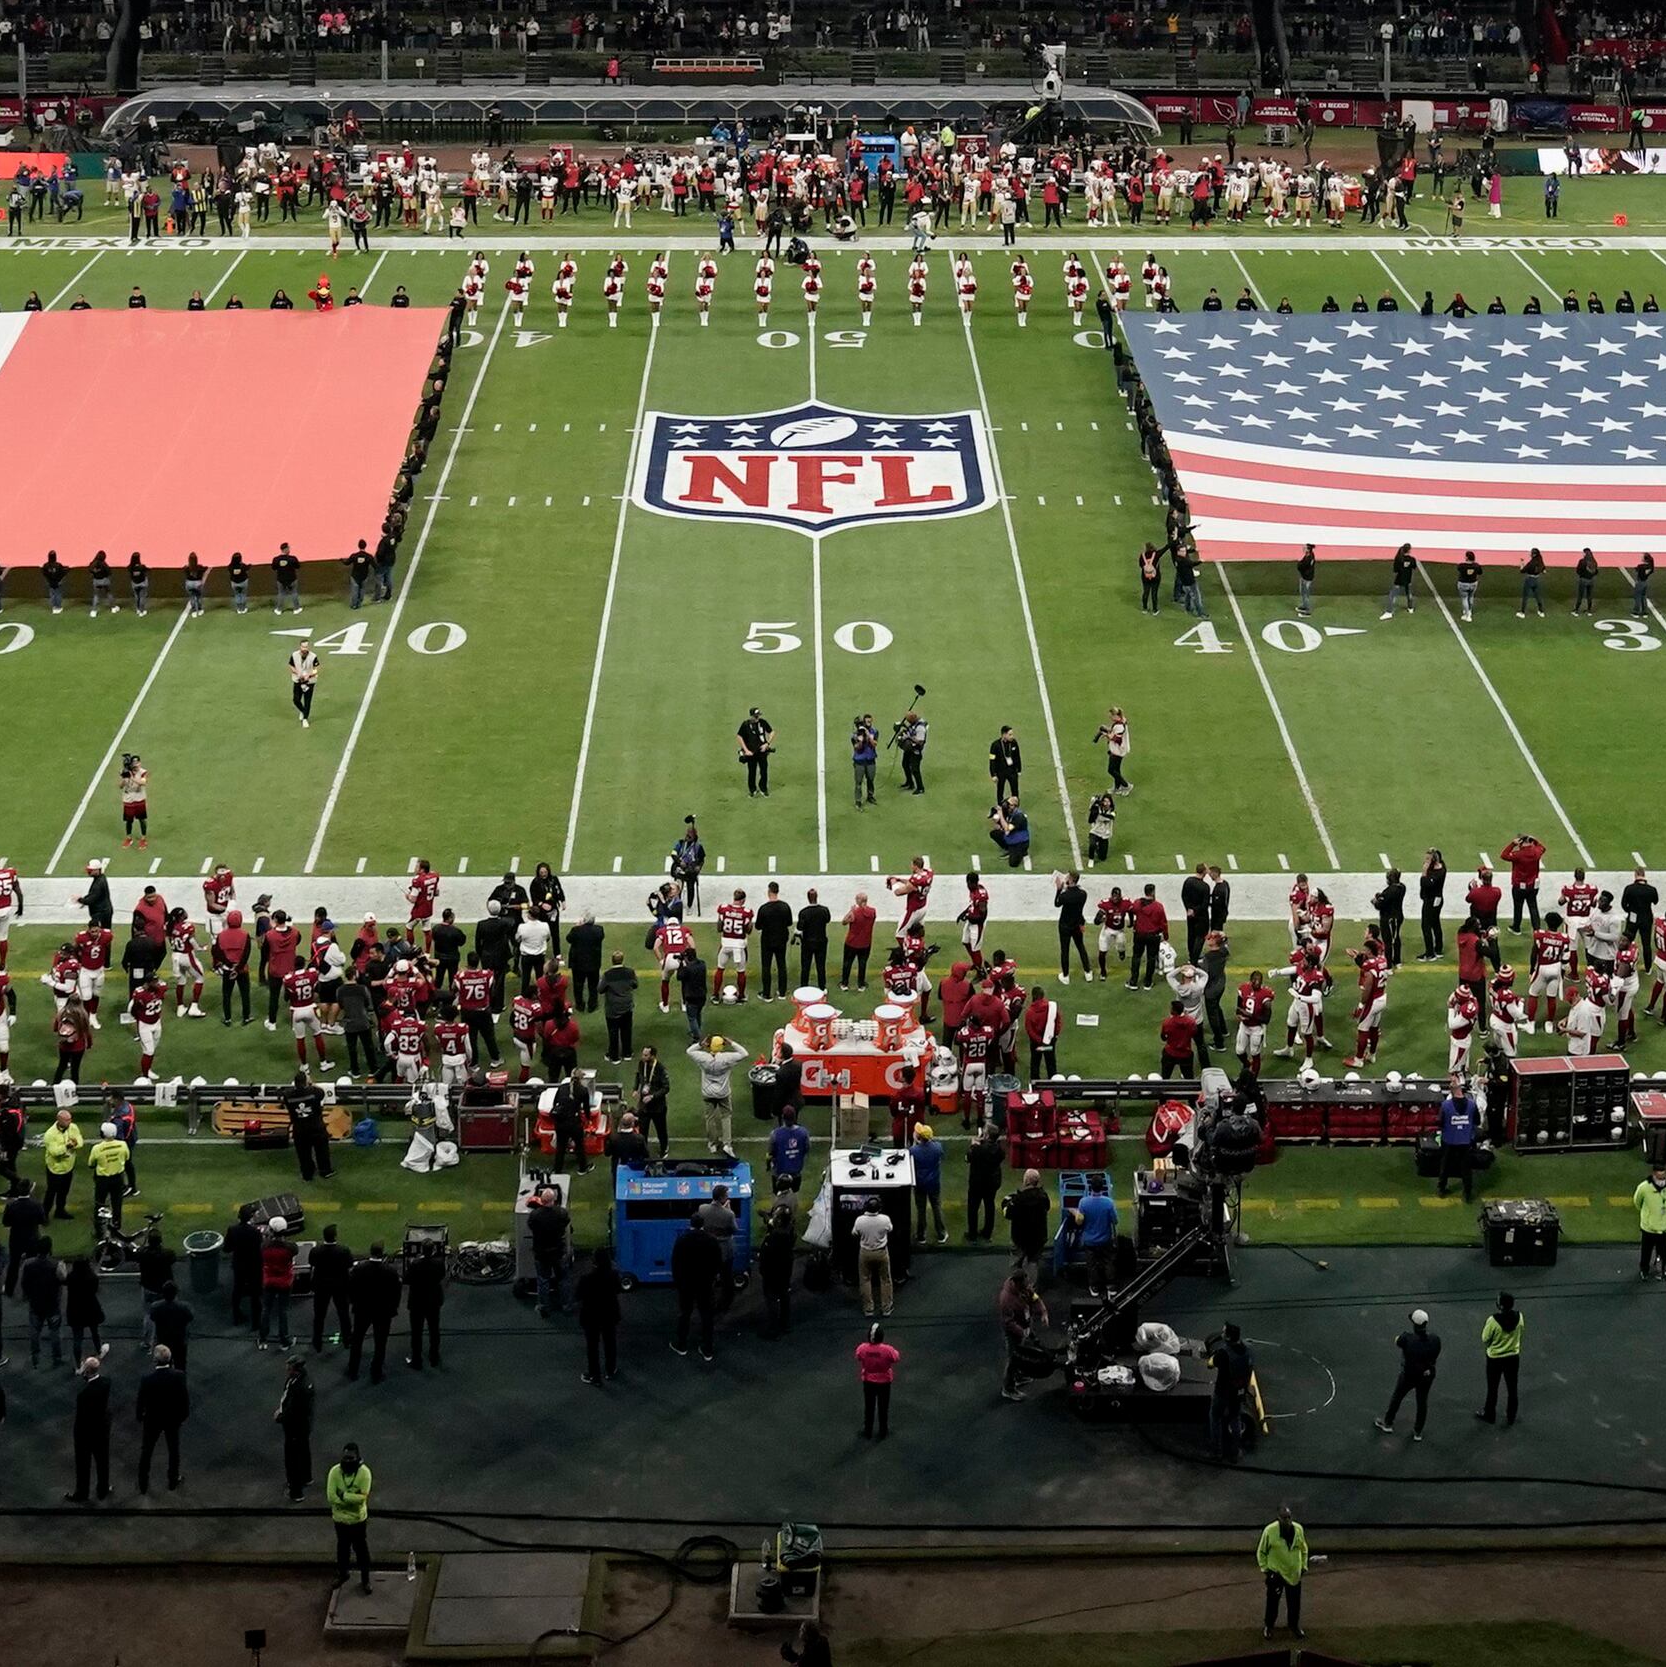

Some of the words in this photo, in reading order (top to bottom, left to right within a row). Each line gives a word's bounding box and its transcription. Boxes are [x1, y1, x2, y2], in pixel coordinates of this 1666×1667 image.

[1405, 238, 1604, 248] MEXICO
[756, 330, 868, 349] 50
[677, 456, 953, 512] NFL
[314, 621, 468, 655] 40
[742, 620, 895, 655] 50
[1174, 620, 1323, 654] 40
[722, 919, 743, 933] 85
[666, 930, 683, 945] 12
[90, 945, 101, 959] 6
[1542, 946, 1562, 960] 41
[465, 985, 485, 1001] 76
[145, 1000, 163, 1017] 23
[1245, 1000, 1256, 1014] 9
[446, 1040, 457, 1054] 4
[969, 1044, 987, 1058] 20
